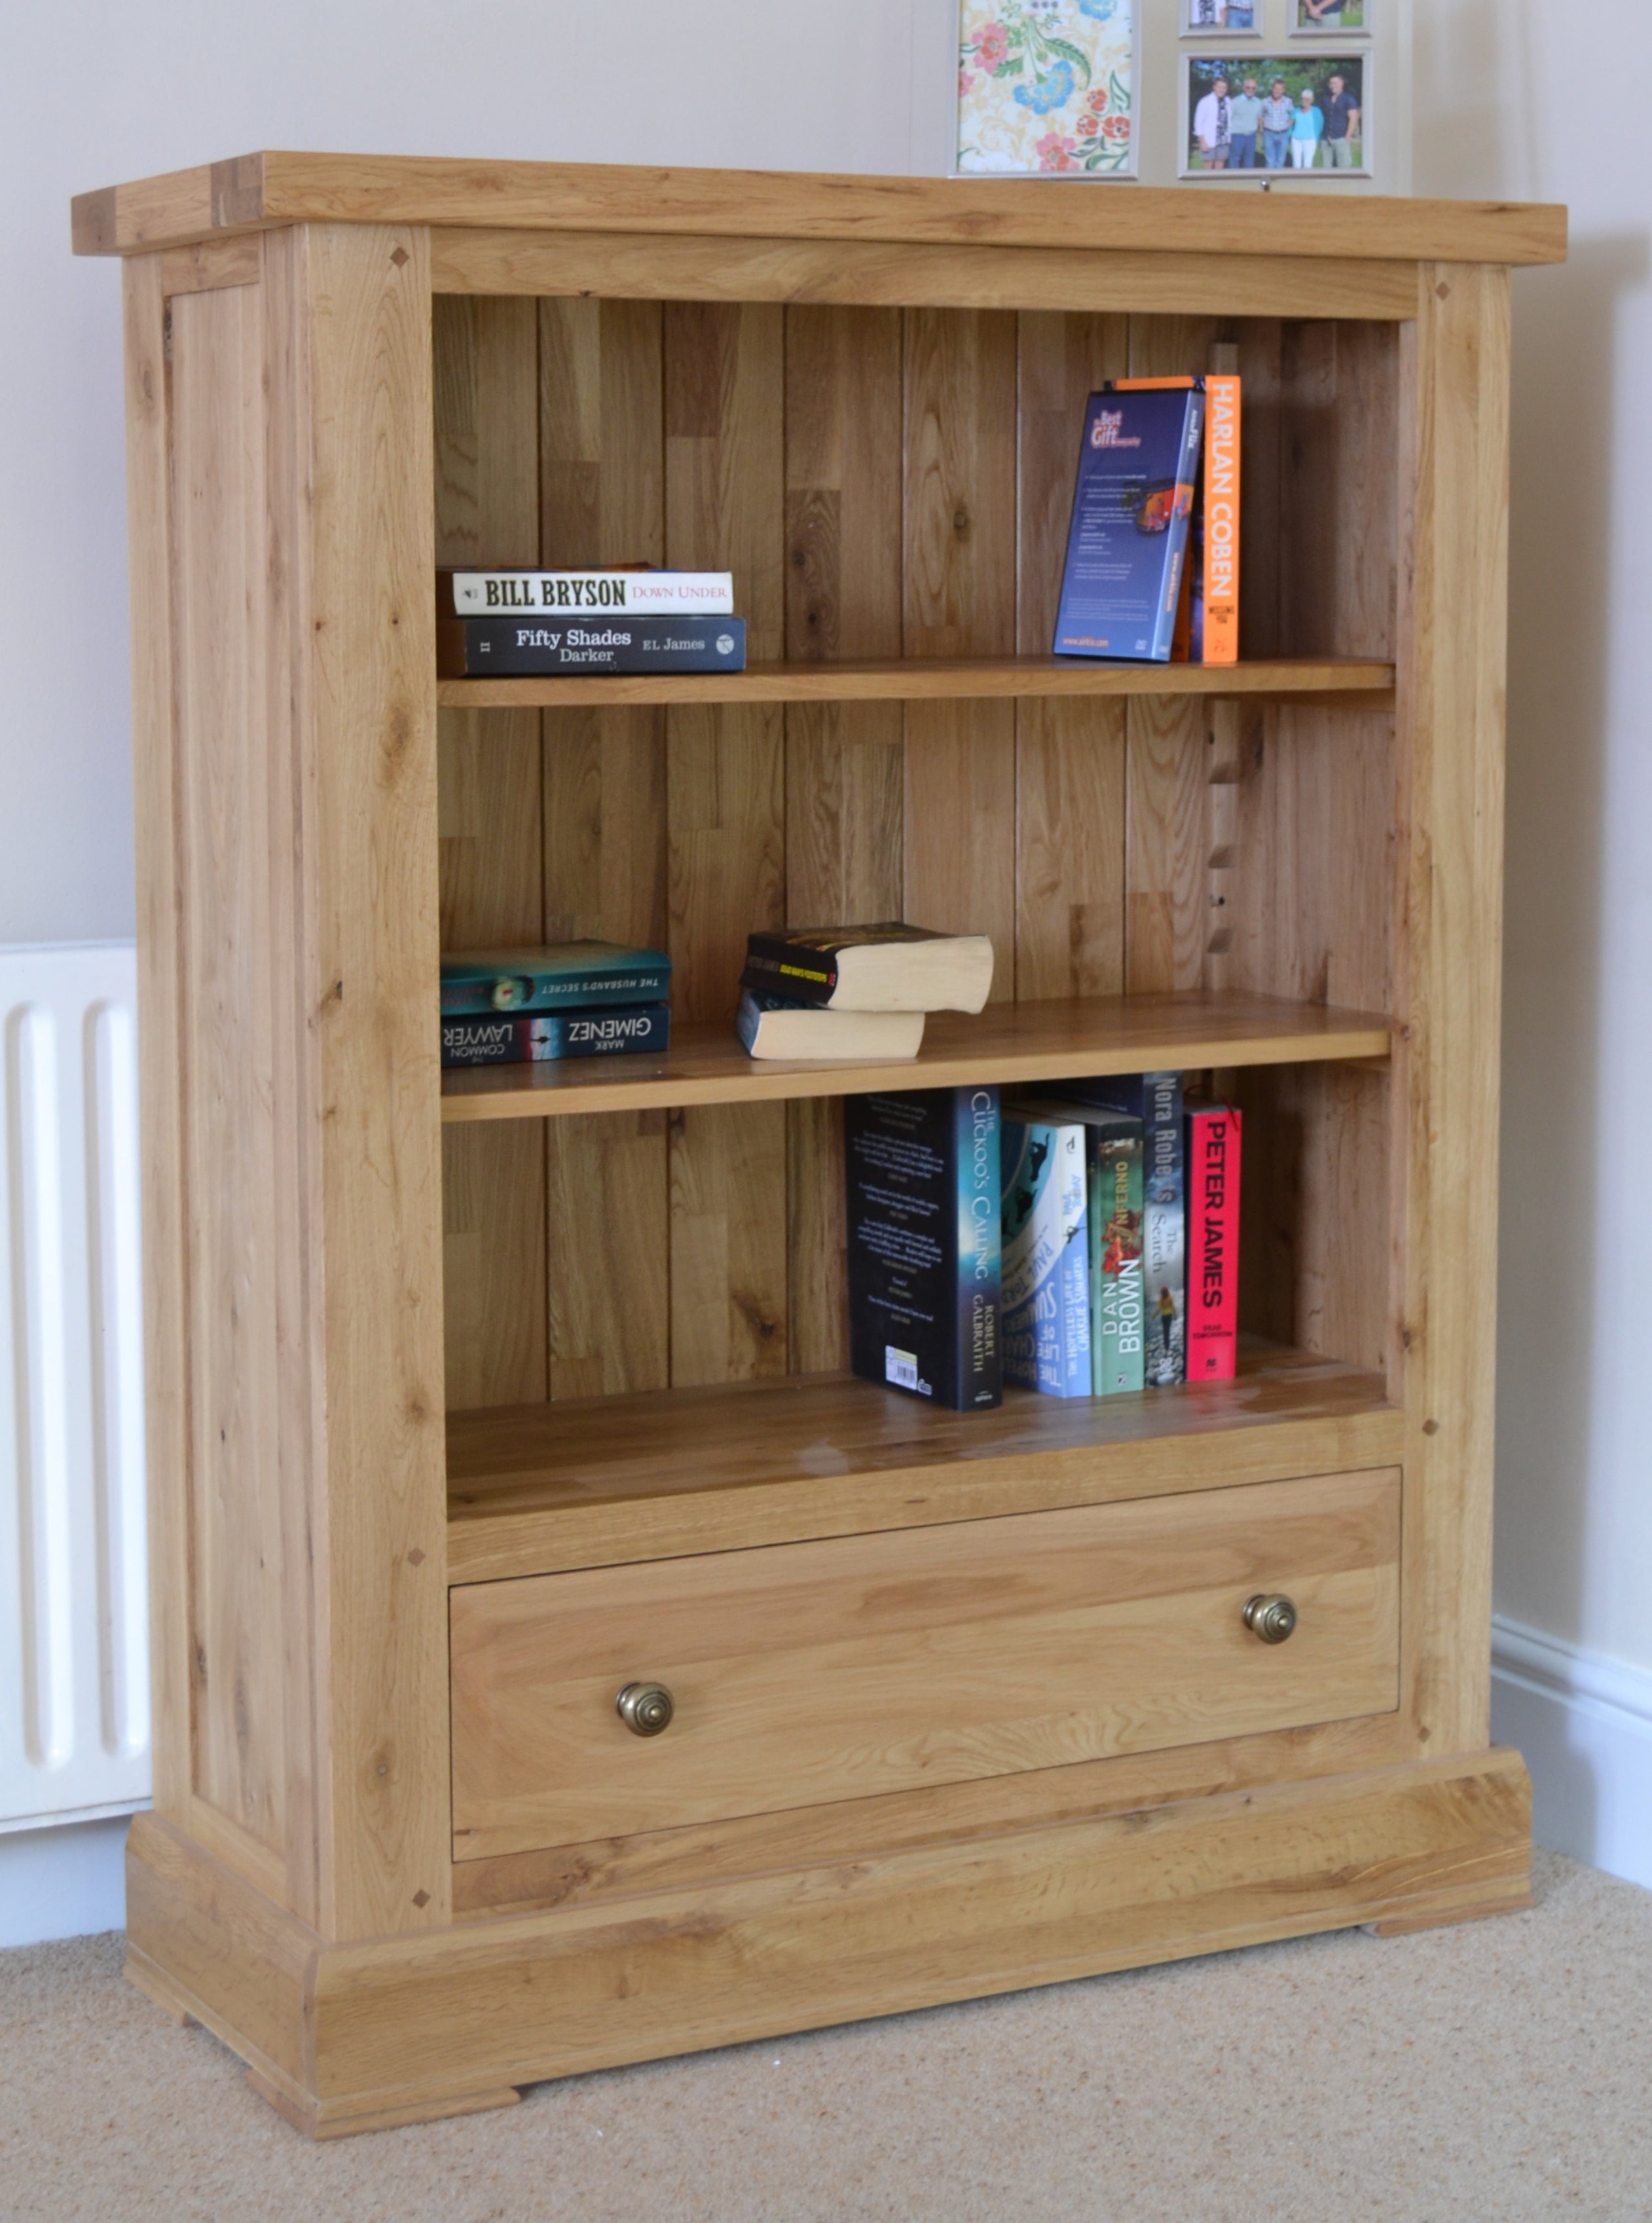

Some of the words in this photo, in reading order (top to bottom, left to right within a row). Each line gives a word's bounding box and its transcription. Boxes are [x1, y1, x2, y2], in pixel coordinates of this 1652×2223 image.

[1091, 427, 1120, 447] Gift
[1211, 384, 1233, 494] HARLAN
[1211, 503, 1233, 597] COBEN
[485, 579, 535, 607] BILL
[541, 579, 627, 607] BRYSON
[632, 586, 674, 600] DOWN
[678, 586, 727, 600] UNDER
[517, 630, 561, 650] Fifty
[566, 630, 632, 646] Shades
[663, 638, 705, 651] James
[560, 649, 614, 663] Darker
[541, 983, 579, 994] SECRET
[581, 979, 636, 991] HUSBAND'S
[639, 978, 659, 988] THE
[444, 1024, 513, 1046] LAWYER
[568, 1017, 652, 1042] GIMENEZ
[450, 1044, 505, 1058] COMMON
[595, 1039, 625, 1050] MARK
[1155, 1078, 1177, 1122] Nora
[970, 1091, 991, 1190] CUCKOO'S
[1155, 1130, 1177, 1203] Roberts
[1205, 1121, 1226, 1210] PETER
[970, 1196, 991, 1280] CALLING
[1152, 1213, 1167, 1274] Search
[1167, 1231, 1178, 1255] The
[1202, 1219, 1226, 1308] JAMES
[1066, 1285, 1076, 1312] LIFE
[1102, 1281, 1117, 1336] DAN
[1118, 1258, 1140, 1354] BROWN
[973, 1295, 984, 1373] GALBRAITH
[984, 1305, 995, 1357] ROBERT
[1042, 1325, 1055, 1340] OF
[1066, 1315, 1078, 1357] HOPELESS
[1076, 1309, 1090, 1353] CHARLIE
[1037, 1342, 1059, 1361] LIFE
[1041, 1365, 1061, 1387] THE
[1068, 1359, 1078, 1379] THE
